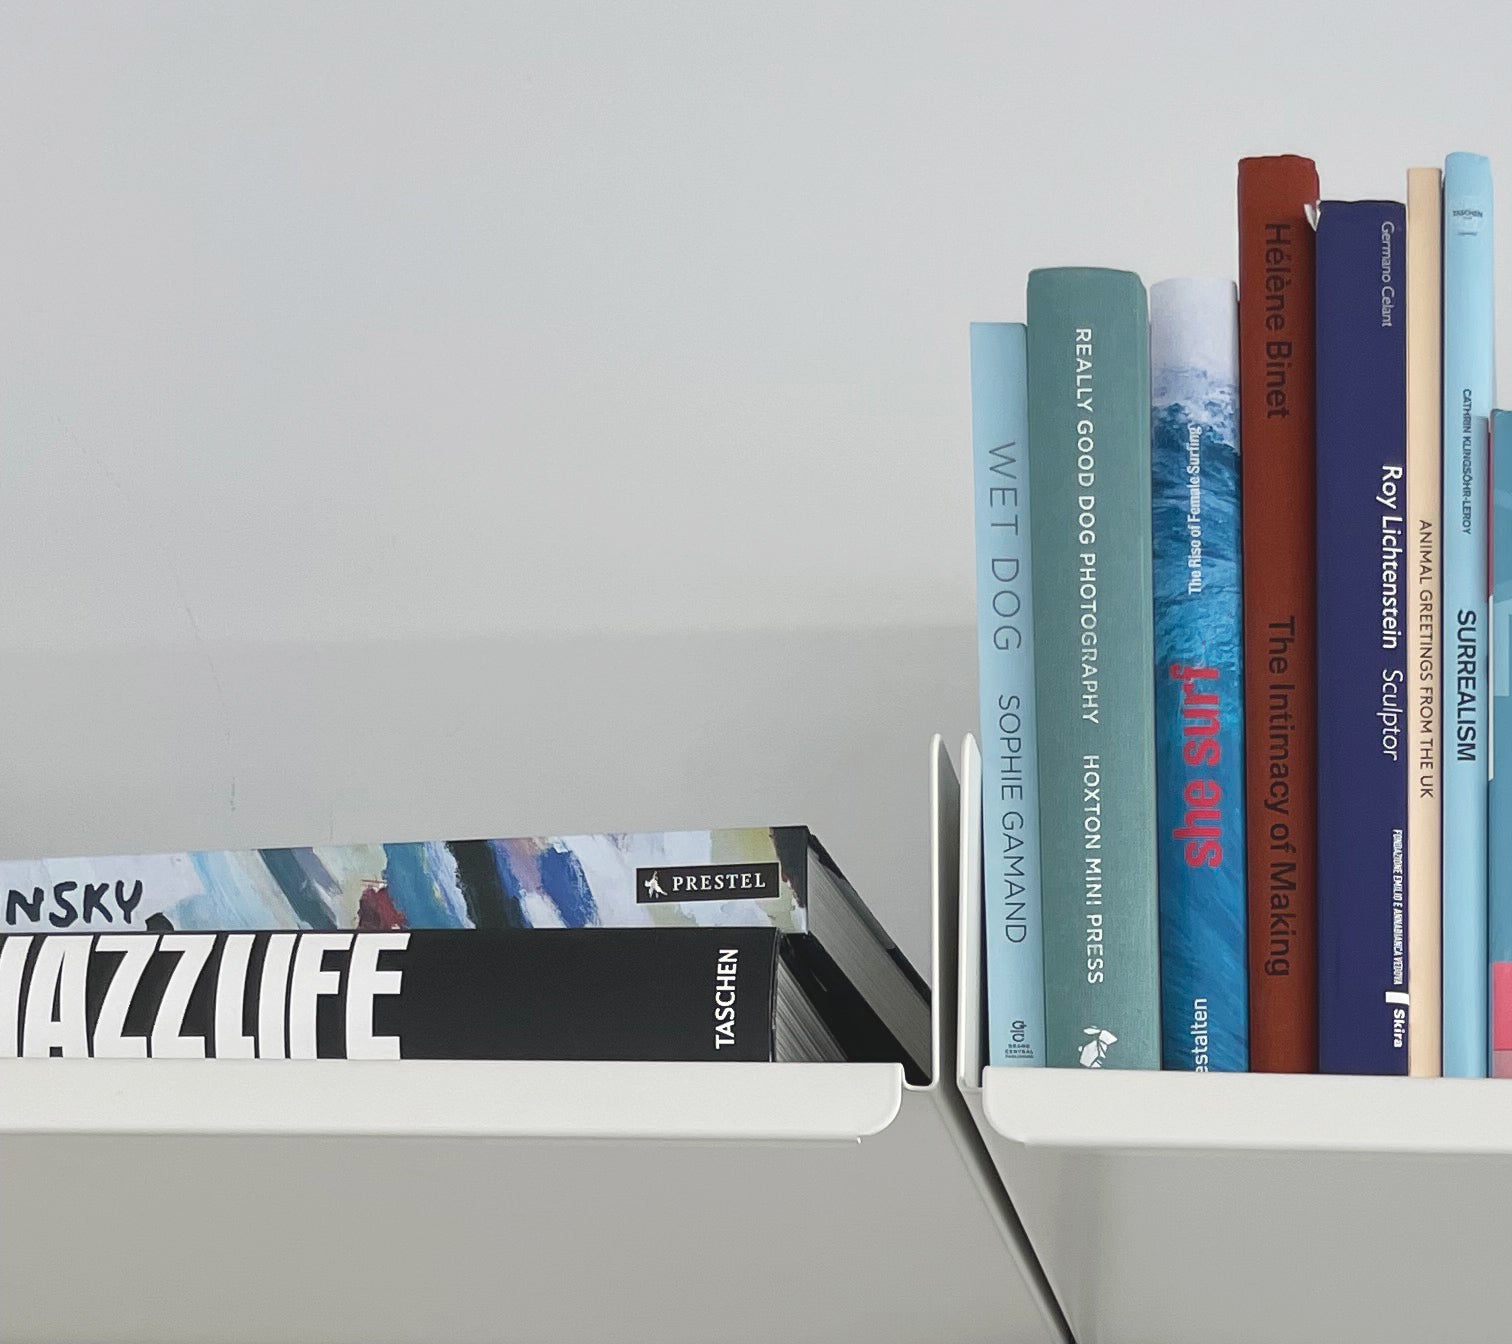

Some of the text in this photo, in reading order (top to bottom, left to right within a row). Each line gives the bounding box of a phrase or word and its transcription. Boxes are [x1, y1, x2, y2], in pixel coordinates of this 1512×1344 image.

[1380, 221, 1395, 328] Germano Celant
[988, 442, 1022, 651] WET DOG
[1074, 328, 1100, 724] REALLY GOOD DOG PHOTOGRAPHY
[1375, 465, 1404, 650] Roy Lichtenstein
[1375, 669, 1404, 761] Sculptor
[1418, 520, 1434, 799] ANIMAL GREETINGS FROM THE UK
[1455, 609, 1477, 762] SURREALISM
[998, 695, 1027, 944] SOPHIE GAMAND
[1263, 615, 1297, 977] The Intimacy of Making
[671, 872, 767, 894] PRESTEL
[714, 948, 739, 1050] TASCHEN
[1391, 1008, 1406, 1048] Skira
